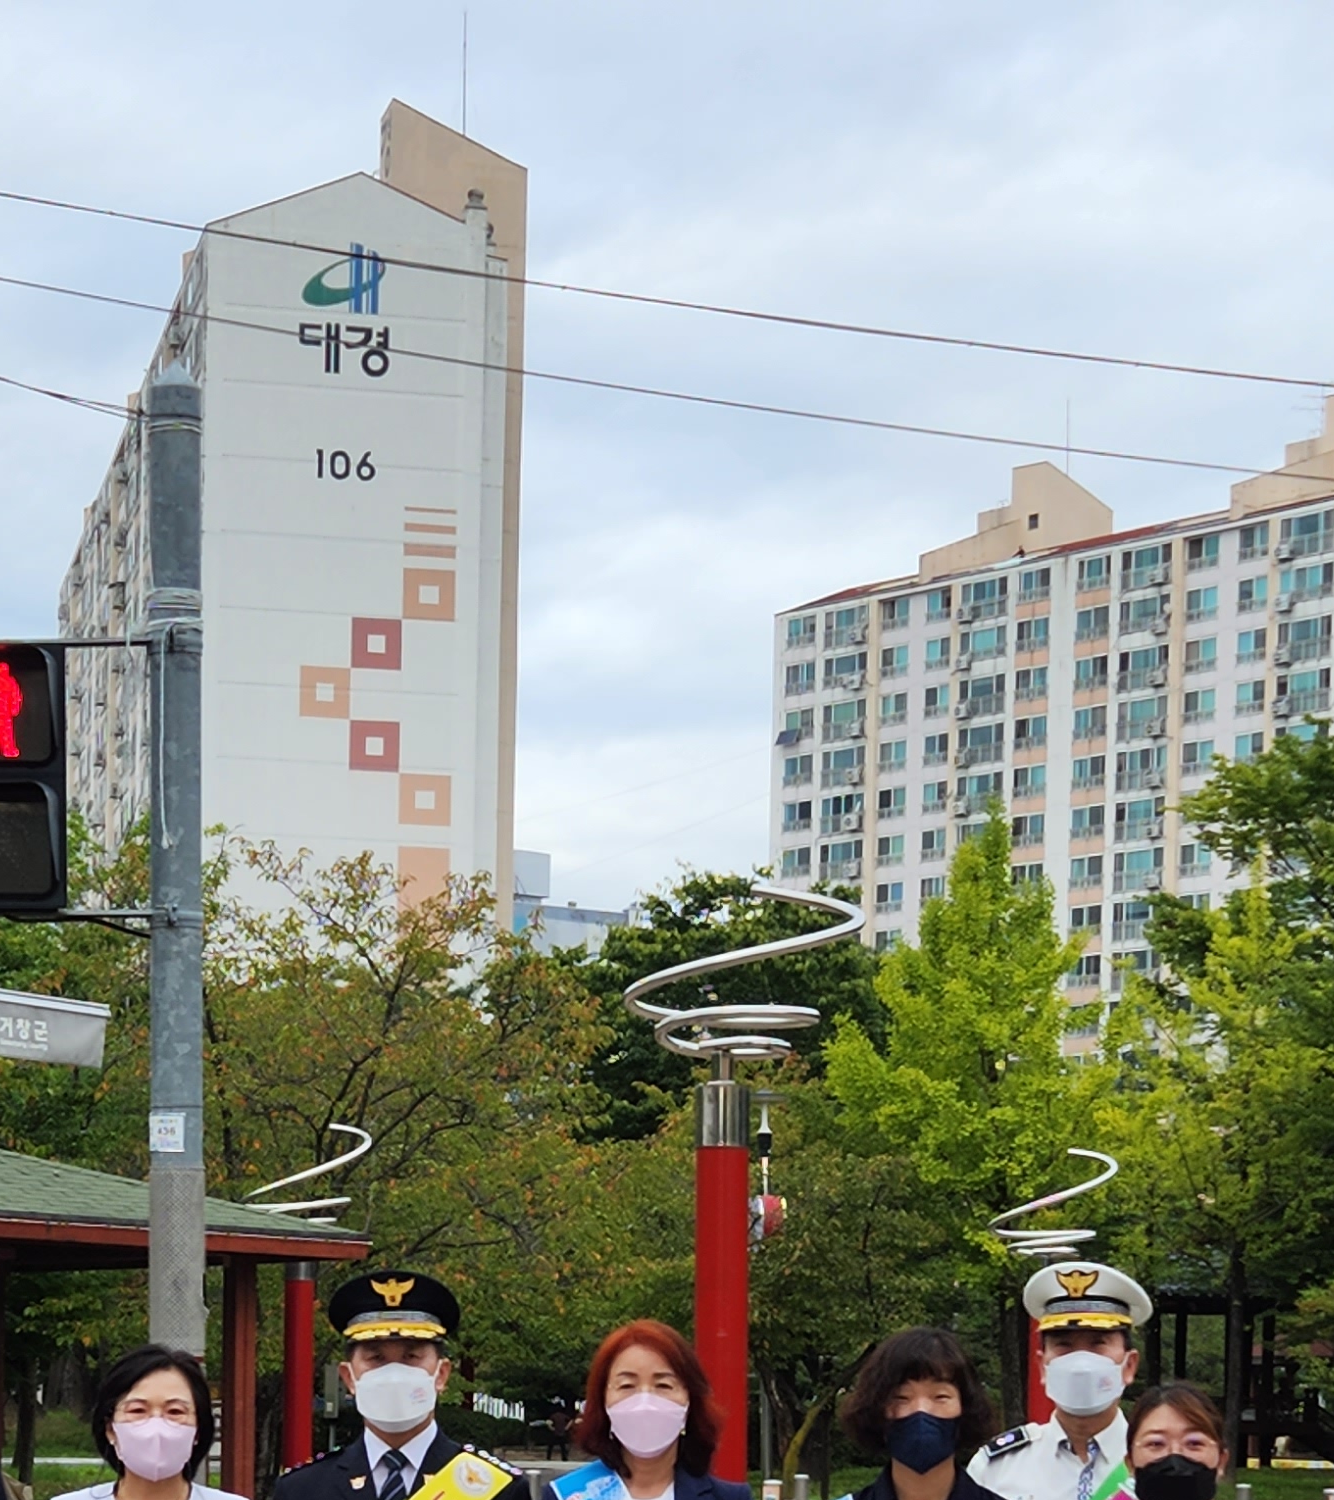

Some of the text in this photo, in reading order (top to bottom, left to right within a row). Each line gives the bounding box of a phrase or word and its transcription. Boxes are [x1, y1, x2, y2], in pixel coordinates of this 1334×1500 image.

[299, 322, 390, 378] 대경
[316, 449, 377, 482] 106
[0, 1016, 49, 1042] 거창군
